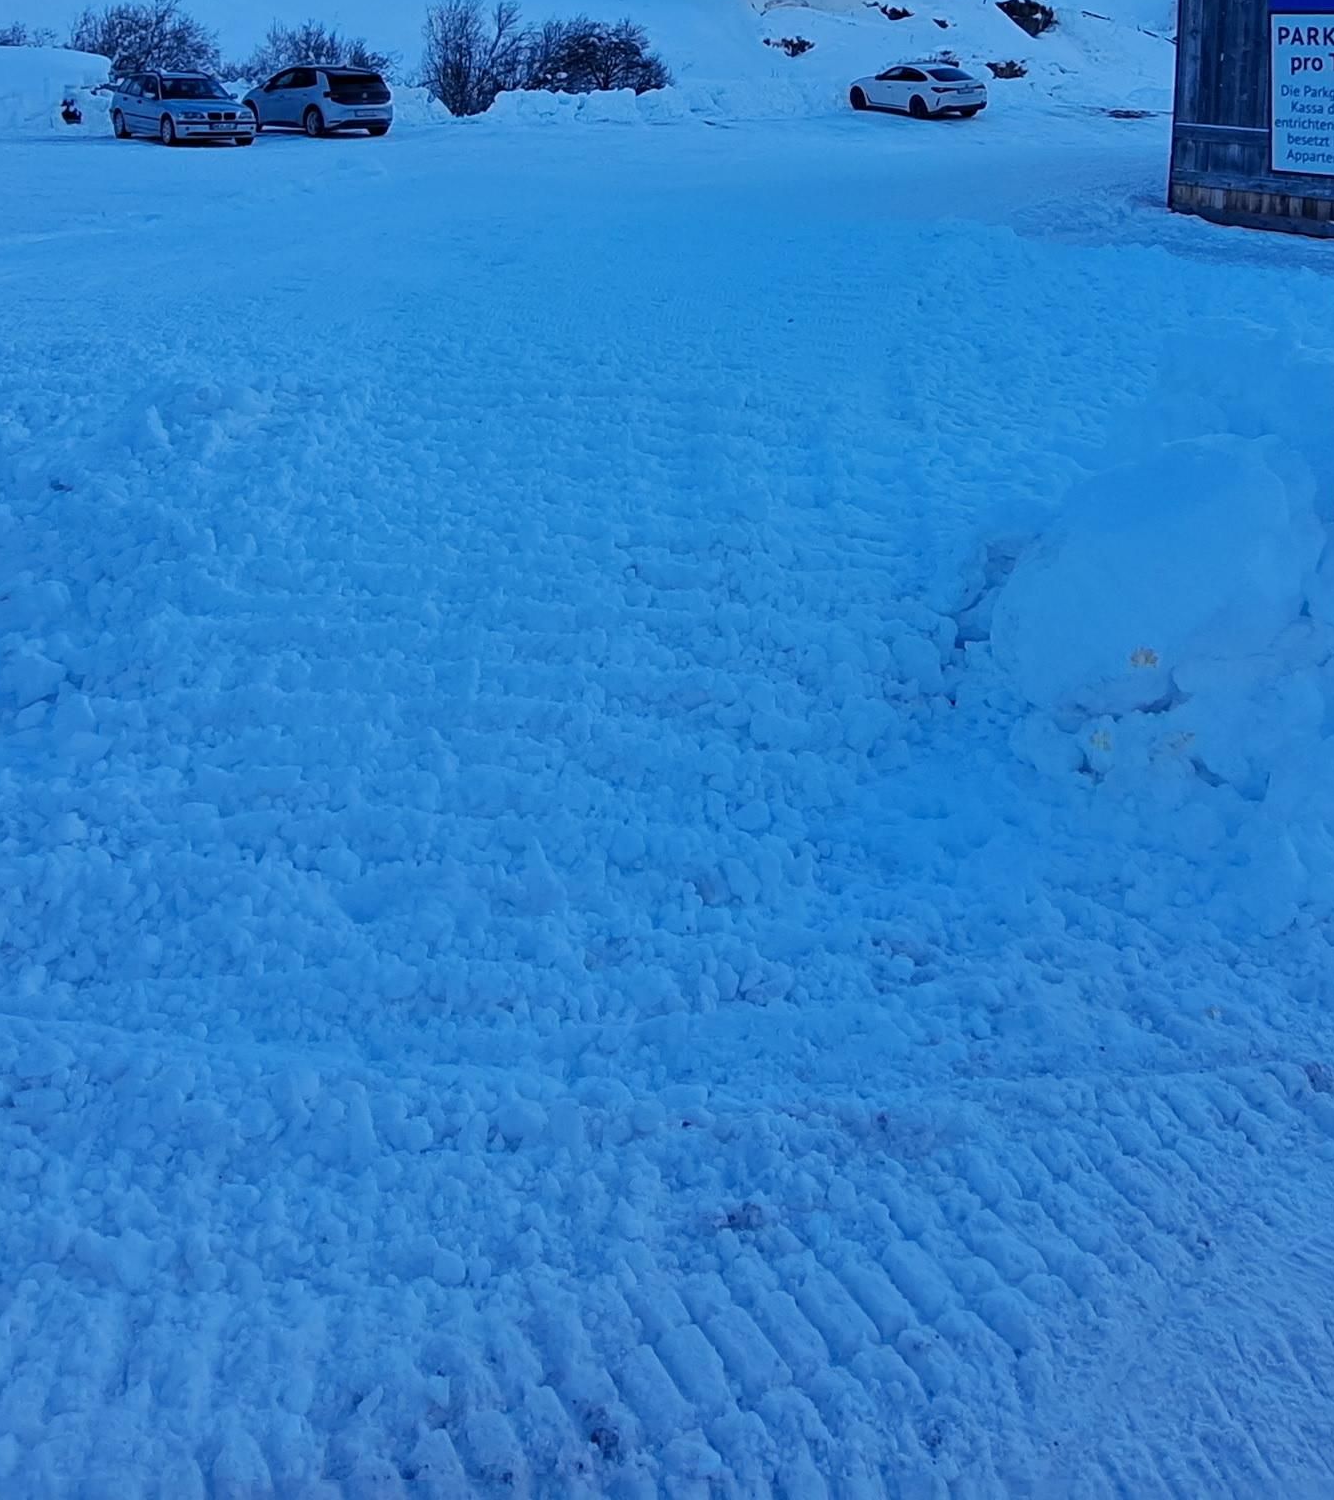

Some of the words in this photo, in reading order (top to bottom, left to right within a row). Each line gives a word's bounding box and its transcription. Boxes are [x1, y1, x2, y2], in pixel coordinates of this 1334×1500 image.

[1291, 56, 1323, 75] pro
[1280, 85, 1300, 97] Die
[1291, 102, 1324, 114] Kassa
[1287, 134, 1329, 147] besetzt
